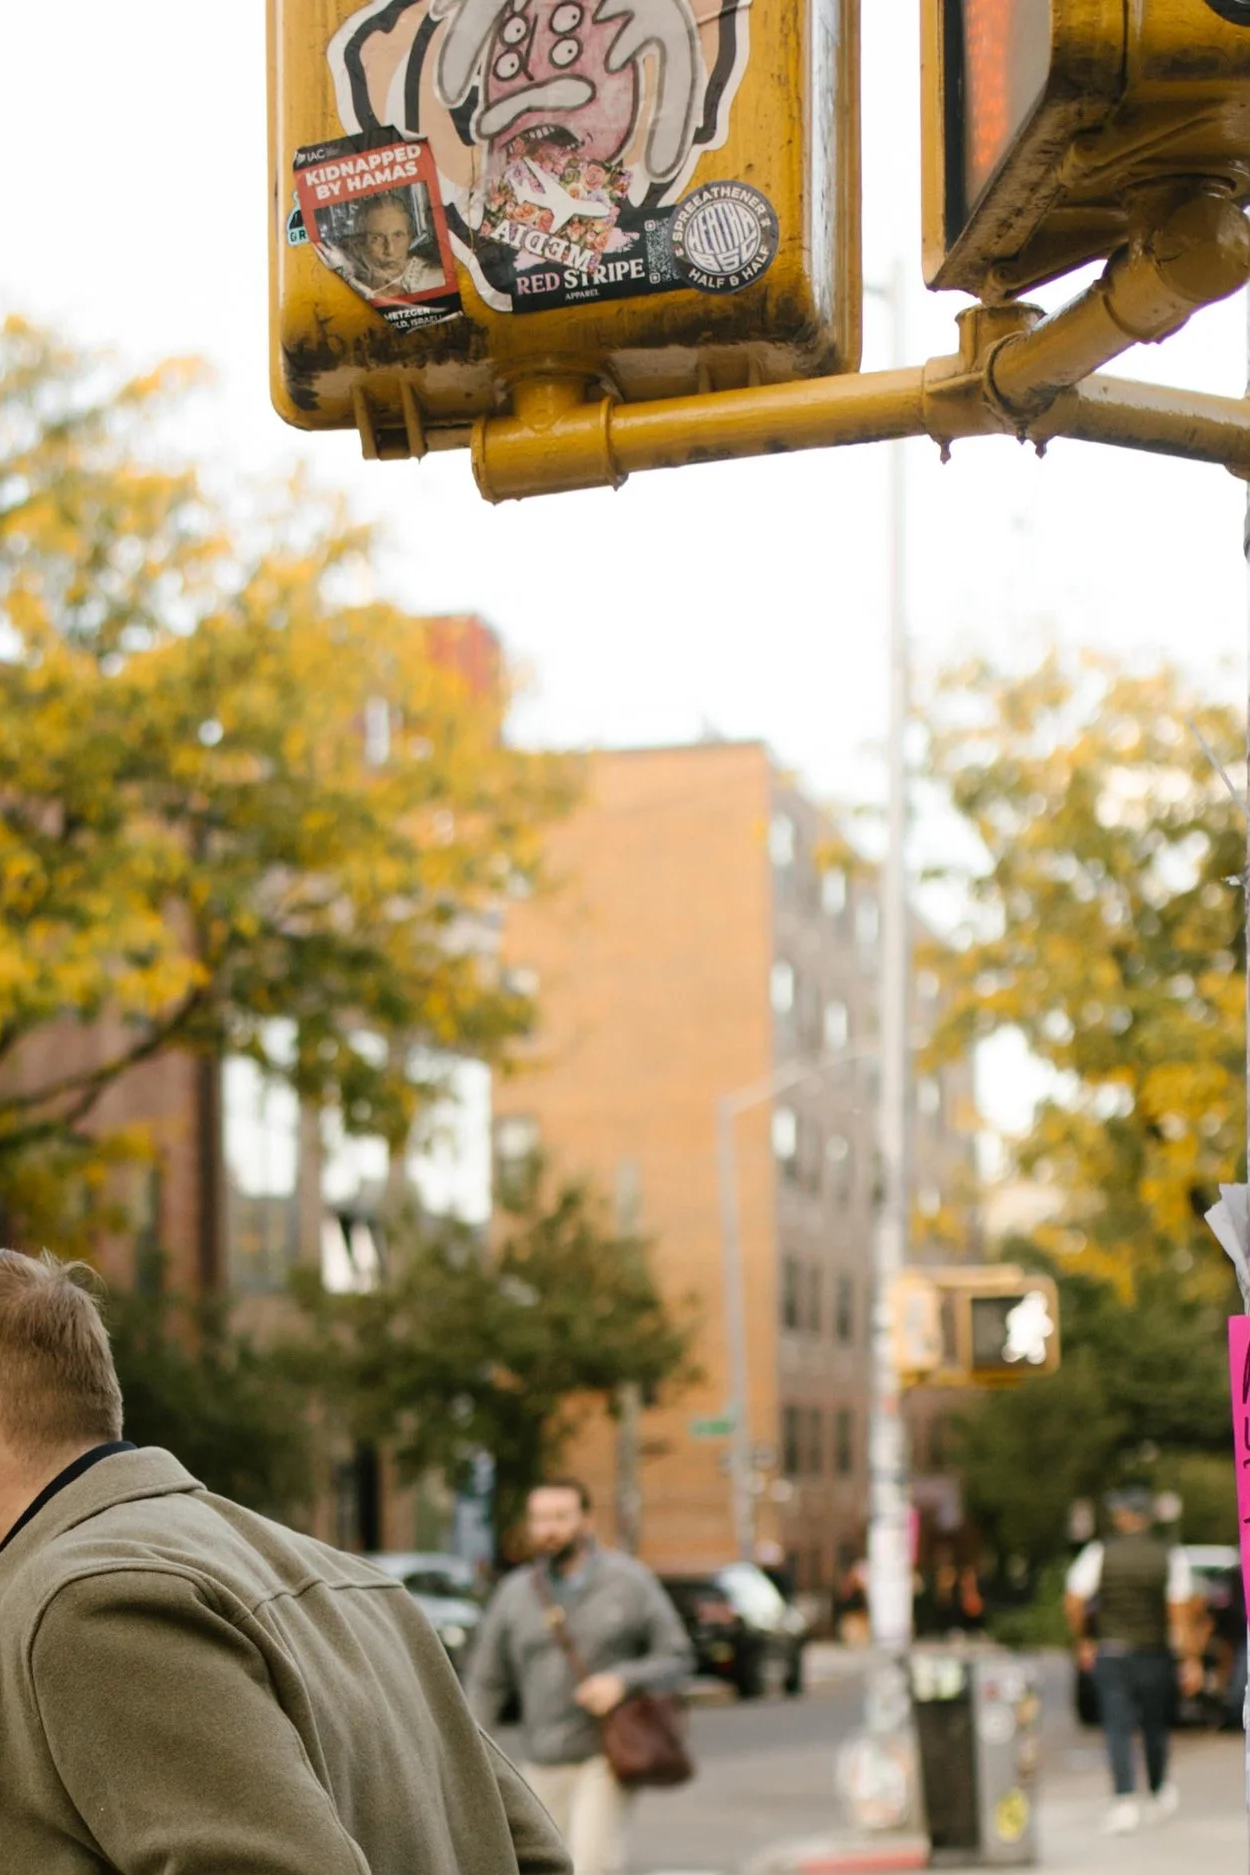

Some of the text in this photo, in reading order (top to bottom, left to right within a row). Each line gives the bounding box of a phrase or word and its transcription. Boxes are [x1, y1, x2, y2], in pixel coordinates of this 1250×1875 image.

[305, 144, 421, 187] KIDNAPPED
[315, 161, 419, 201] BY HAMAS
[672, 185, 767, 242] SPREEATHENER
[516, 258, 646, 296] RED STRIPE
[688, 267, 726, 289] HALF
[741, 245, 770, 281] HALF
[565, 288, 601, 301] APPAREL
